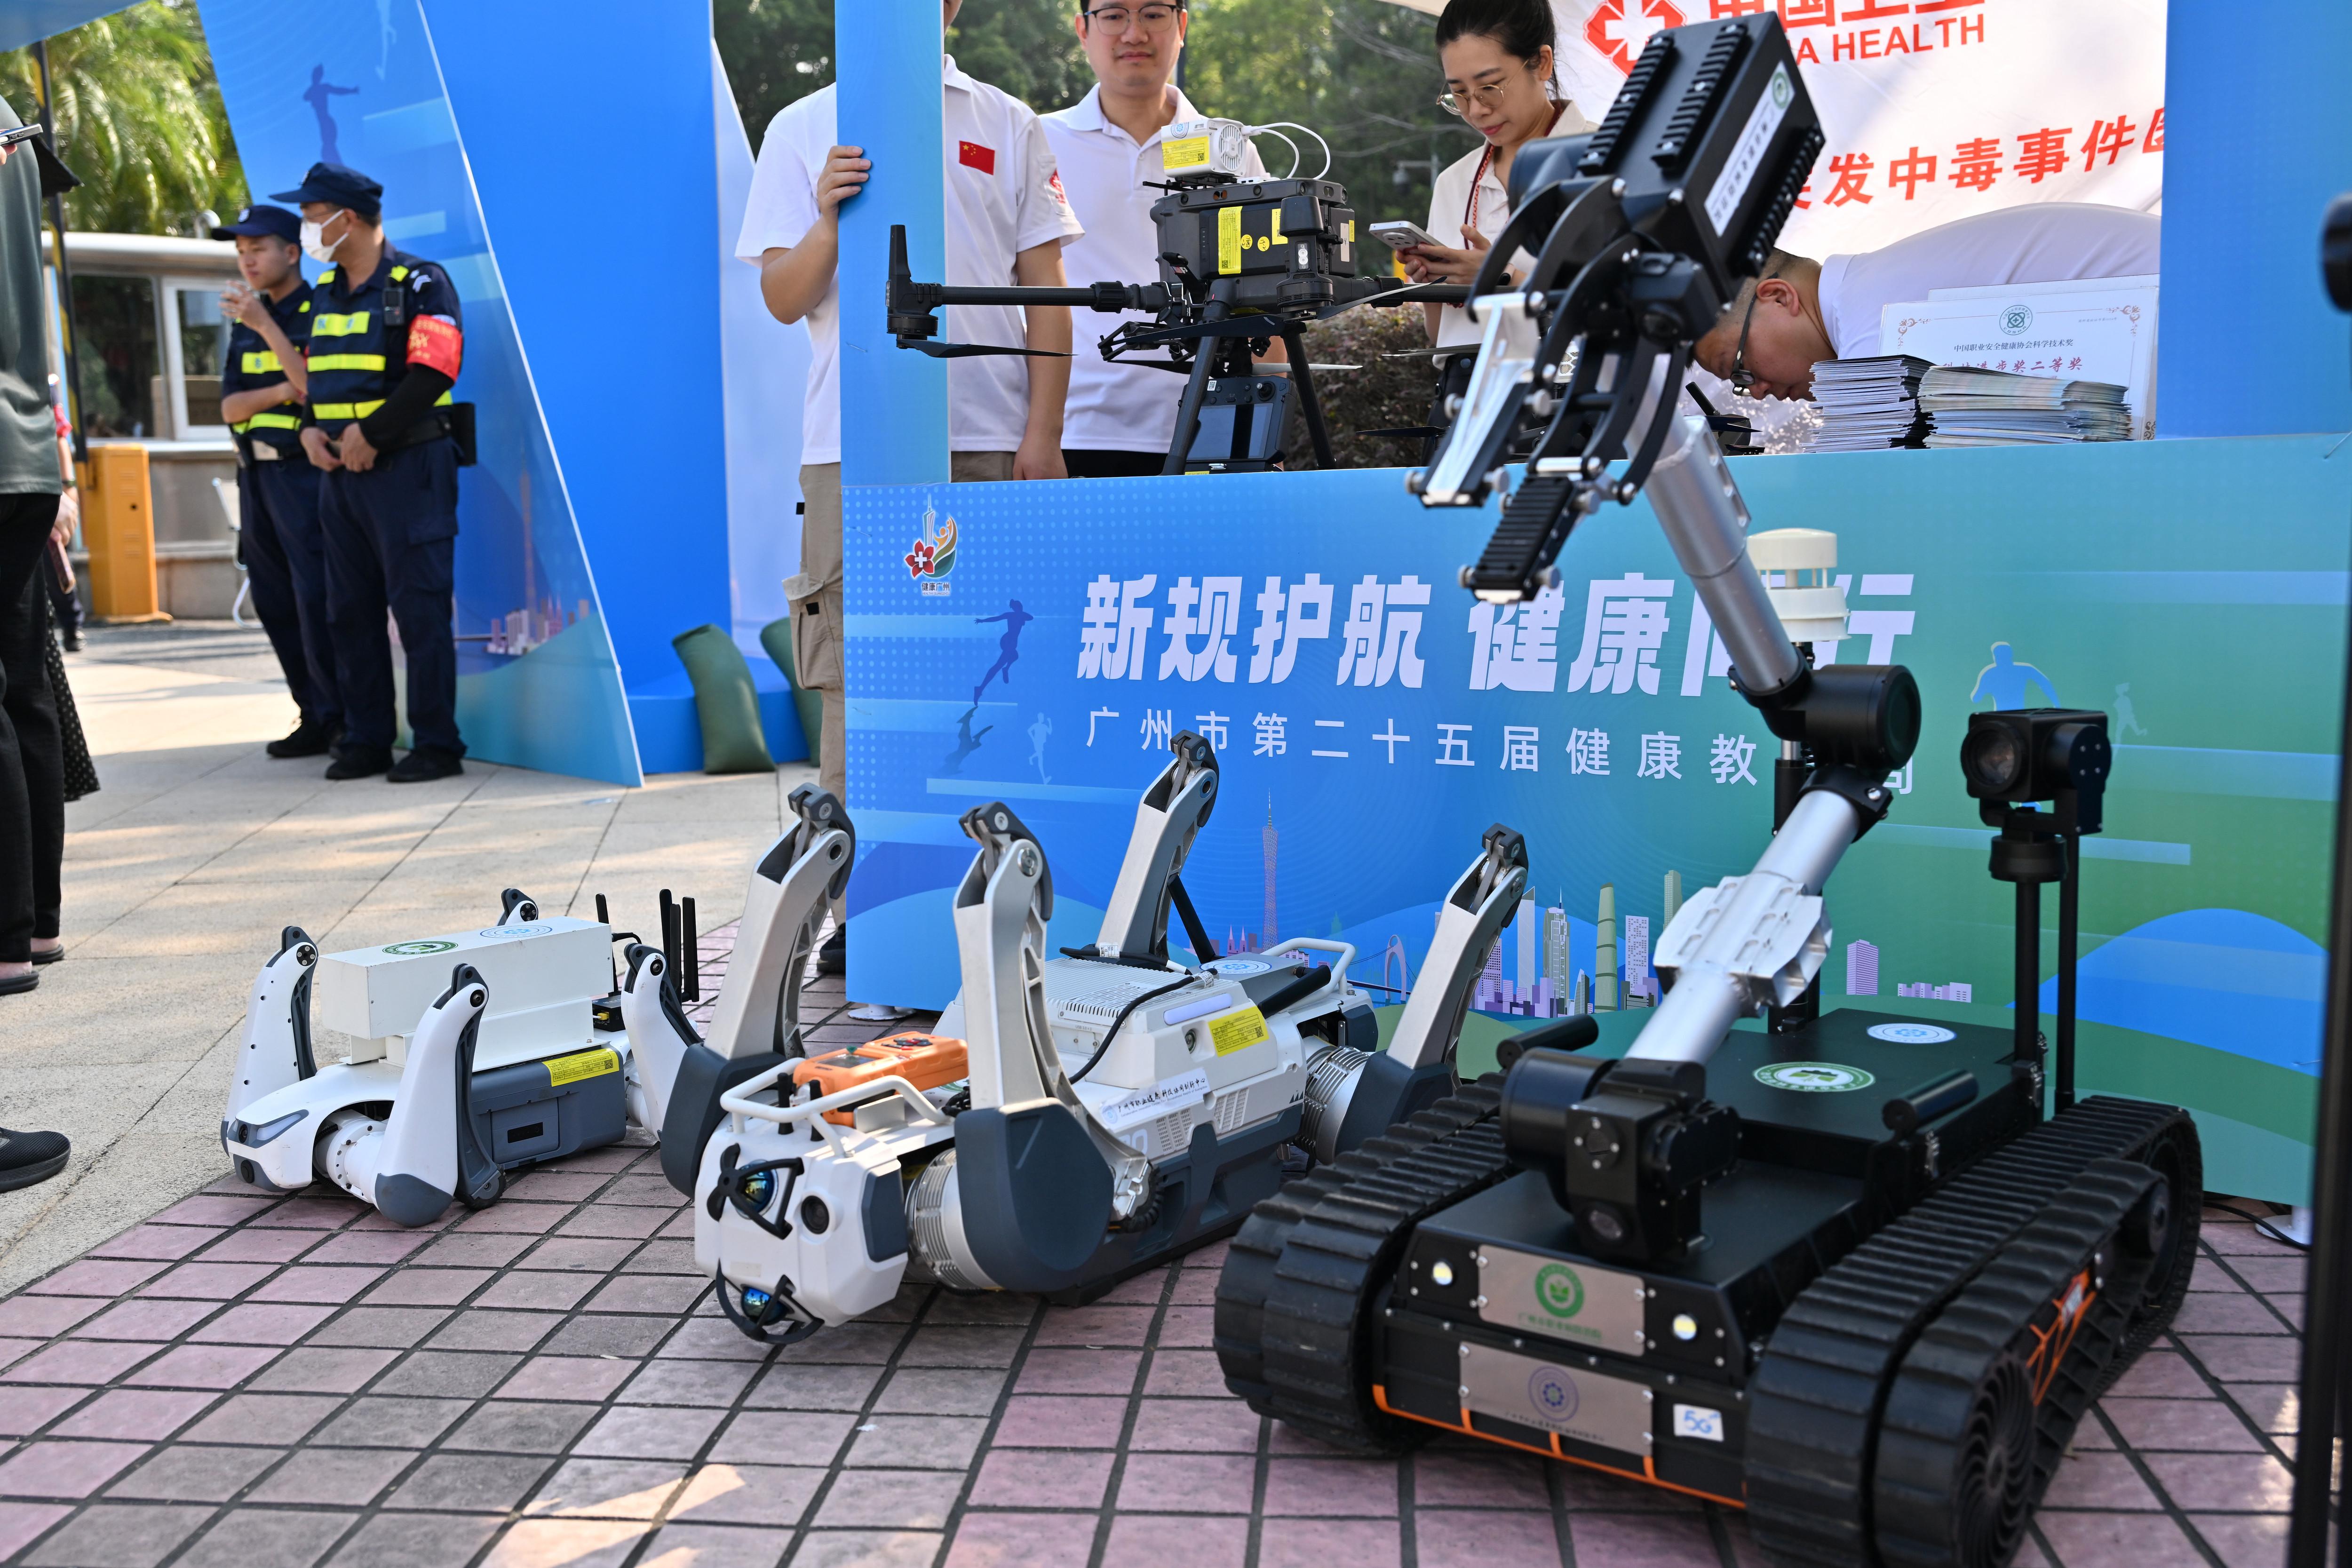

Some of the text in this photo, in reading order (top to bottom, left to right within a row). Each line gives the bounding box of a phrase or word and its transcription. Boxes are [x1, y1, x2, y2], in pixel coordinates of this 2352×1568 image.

[1833, 14, 1984, 62] HEALTH
[1954, 339, 2074, 352] 中国职业安全健康协会科学技术奖
[922, 582, 950, 591] 健康广州
[1077, 573, 1431, 688] 新规护航
[1684, 1410, 1713, 1434] 5G
